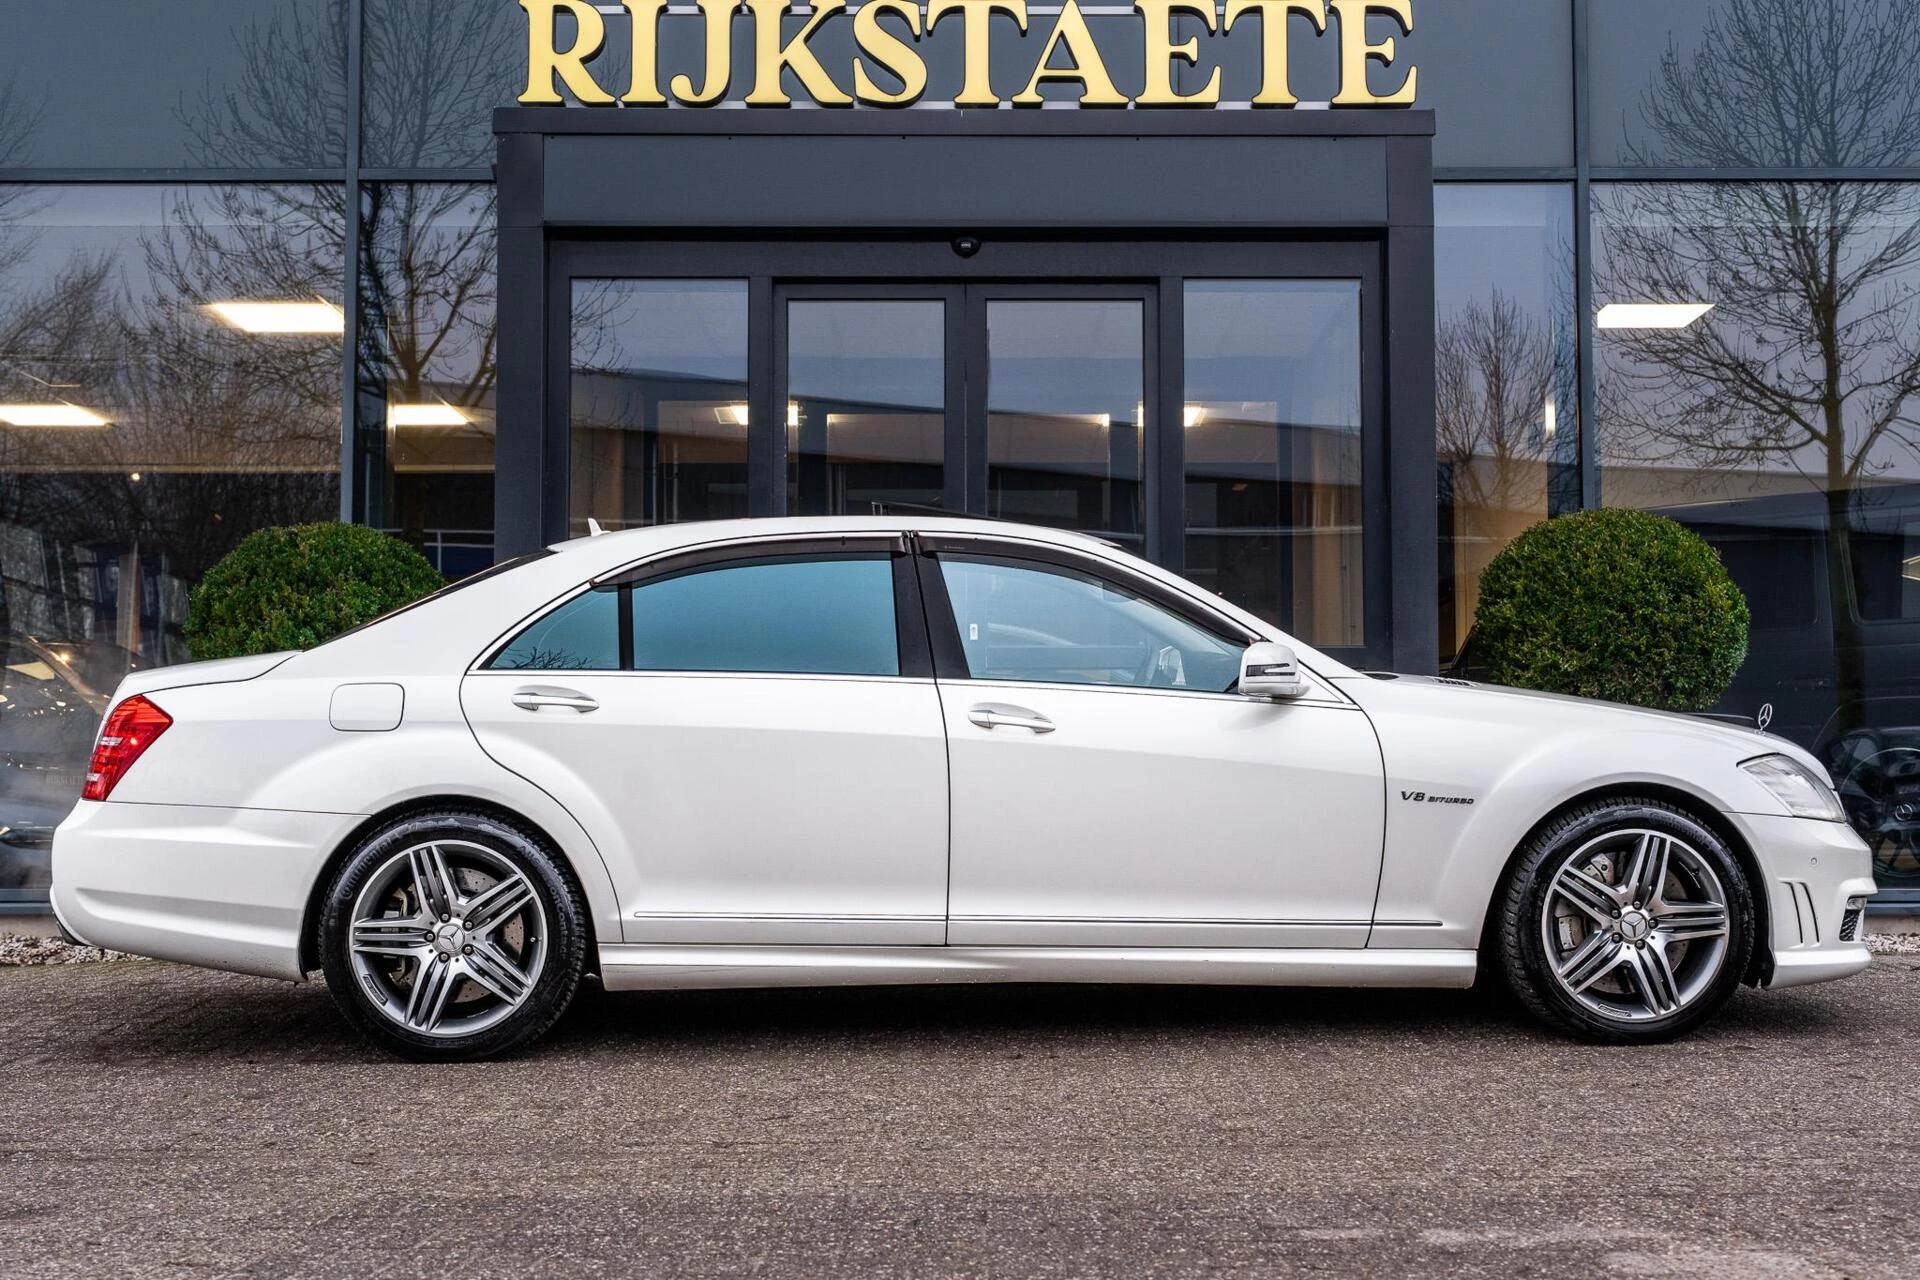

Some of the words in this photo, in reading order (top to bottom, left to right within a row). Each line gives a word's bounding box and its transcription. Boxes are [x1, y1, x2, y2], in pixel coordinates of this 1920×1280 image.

[517, 0, 1418, 107] RIJKSTAETE
[1400, 790, 1426, 802] V8
[1427, 796, 1475, 805] BITURBO
[341, 837, 392, 900] Continental
